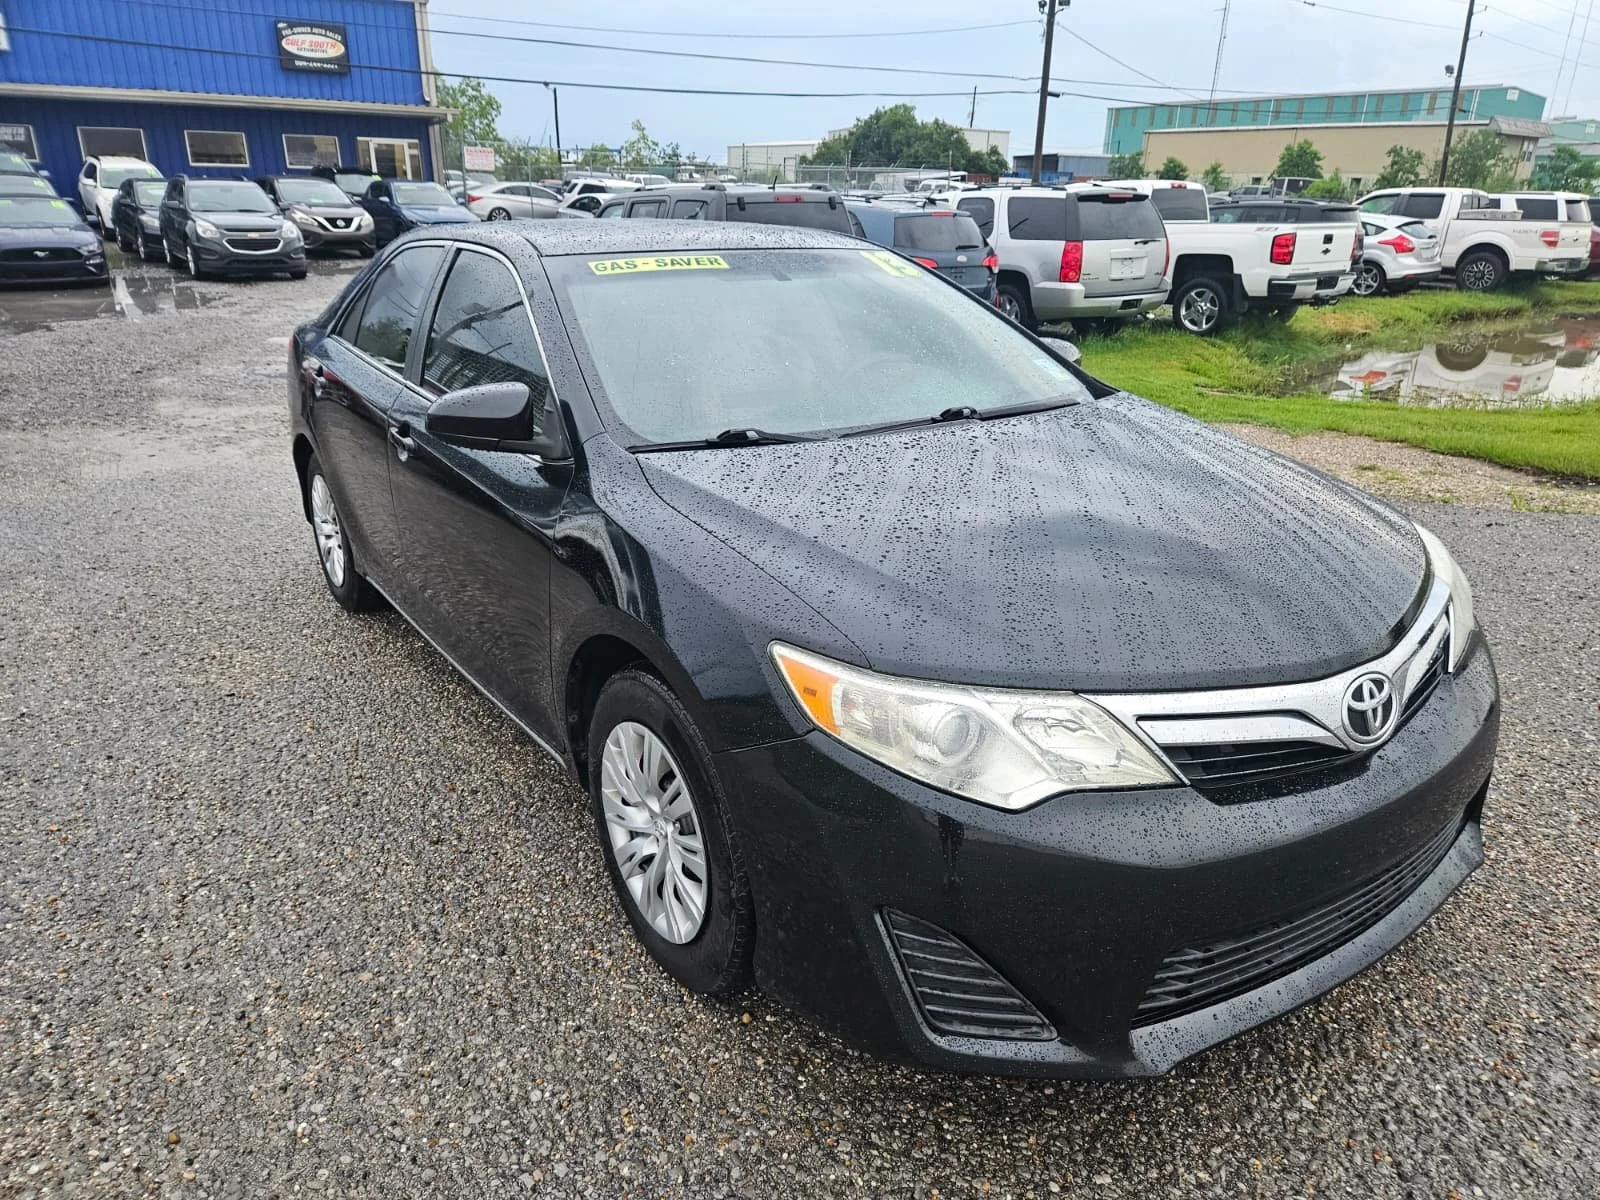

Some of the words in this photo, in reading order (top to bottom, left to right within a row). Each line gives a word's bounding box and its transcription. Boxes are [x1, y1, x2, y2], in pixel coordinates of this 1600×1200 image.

[326, 29, 342, 41] SALES
[285, 38, 307, 46] GULF
[308, 40, 337, 48] SOUTH
